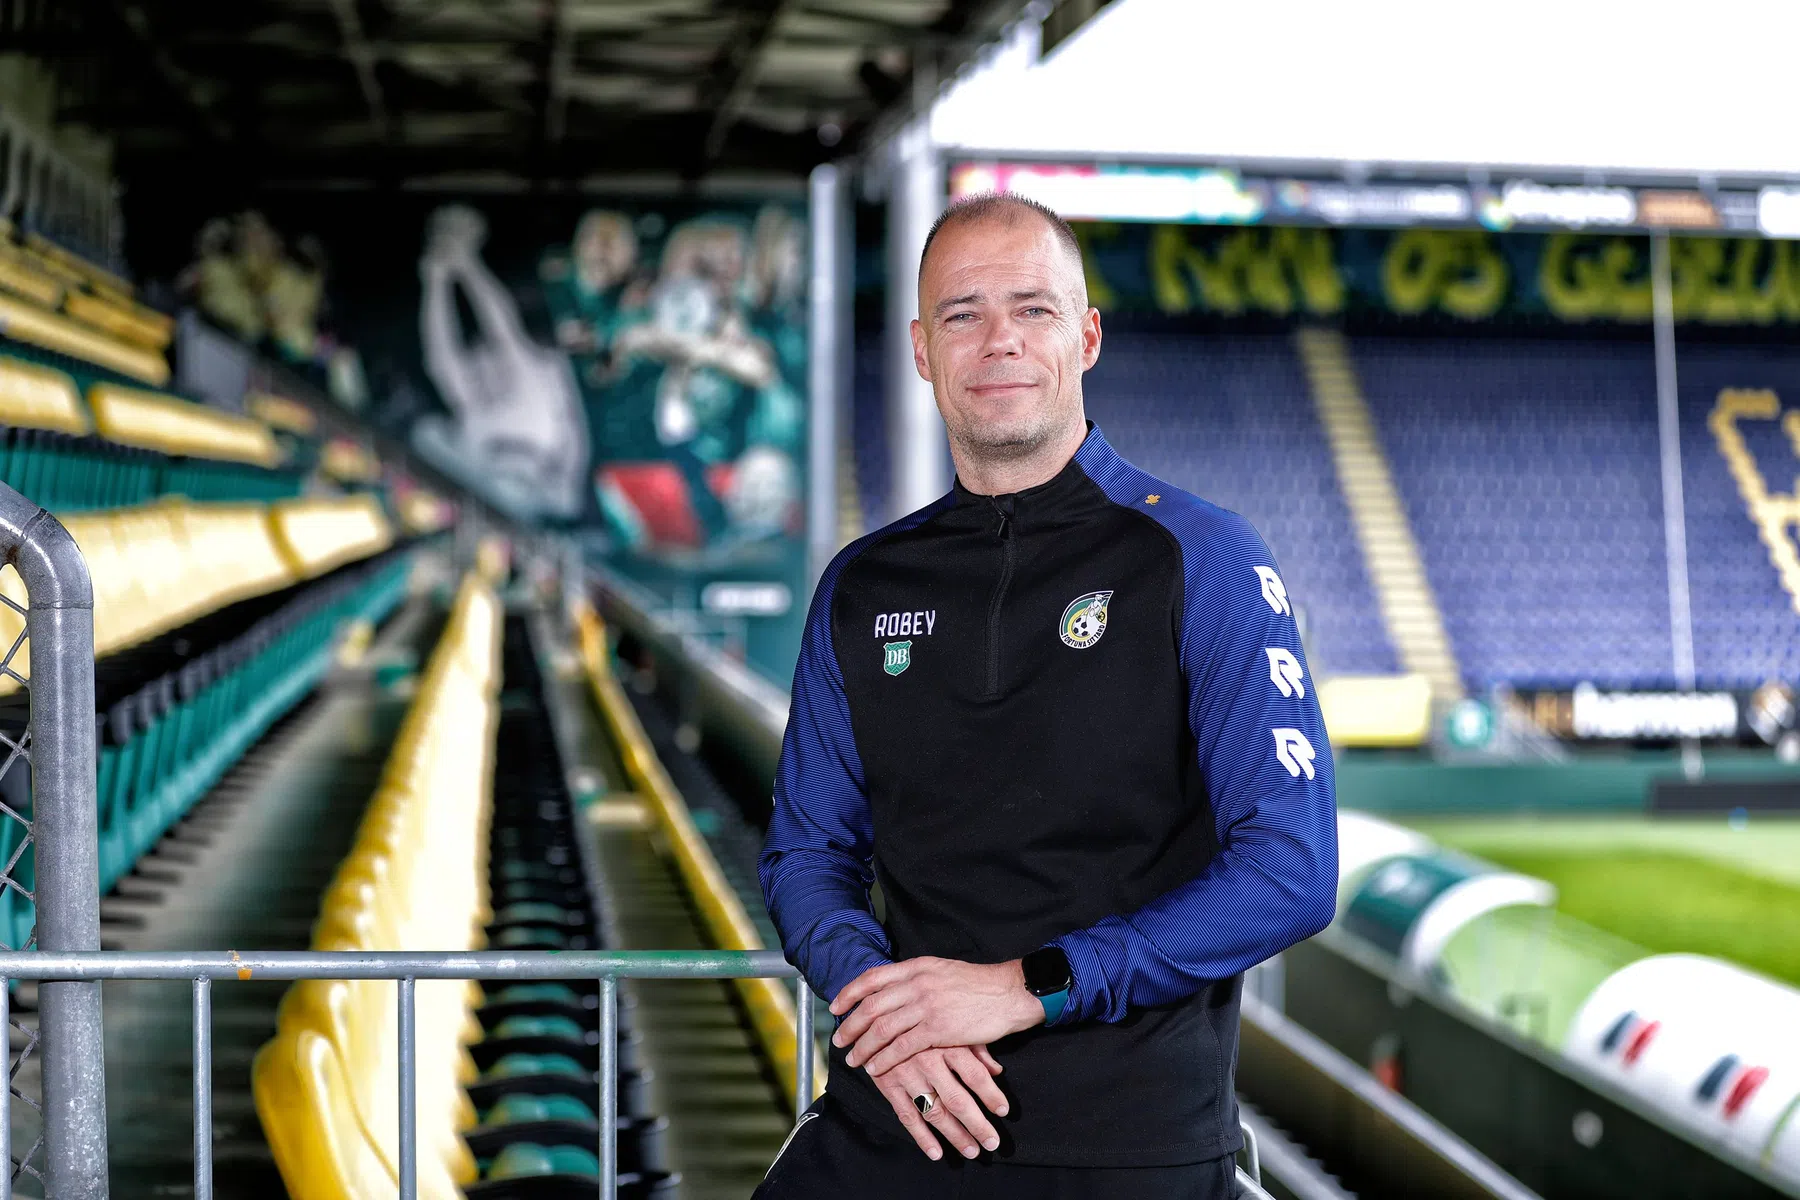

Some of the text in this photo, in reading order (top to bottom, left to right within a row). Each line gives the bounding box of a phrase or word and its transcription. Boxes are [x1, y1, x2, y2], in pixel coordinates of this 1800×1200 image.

[874, 609, 936, 639] ROBEY
[1061, 624, 1106, 648] FORTUNA SITTARD
[887, 648, 908, 666] DB
